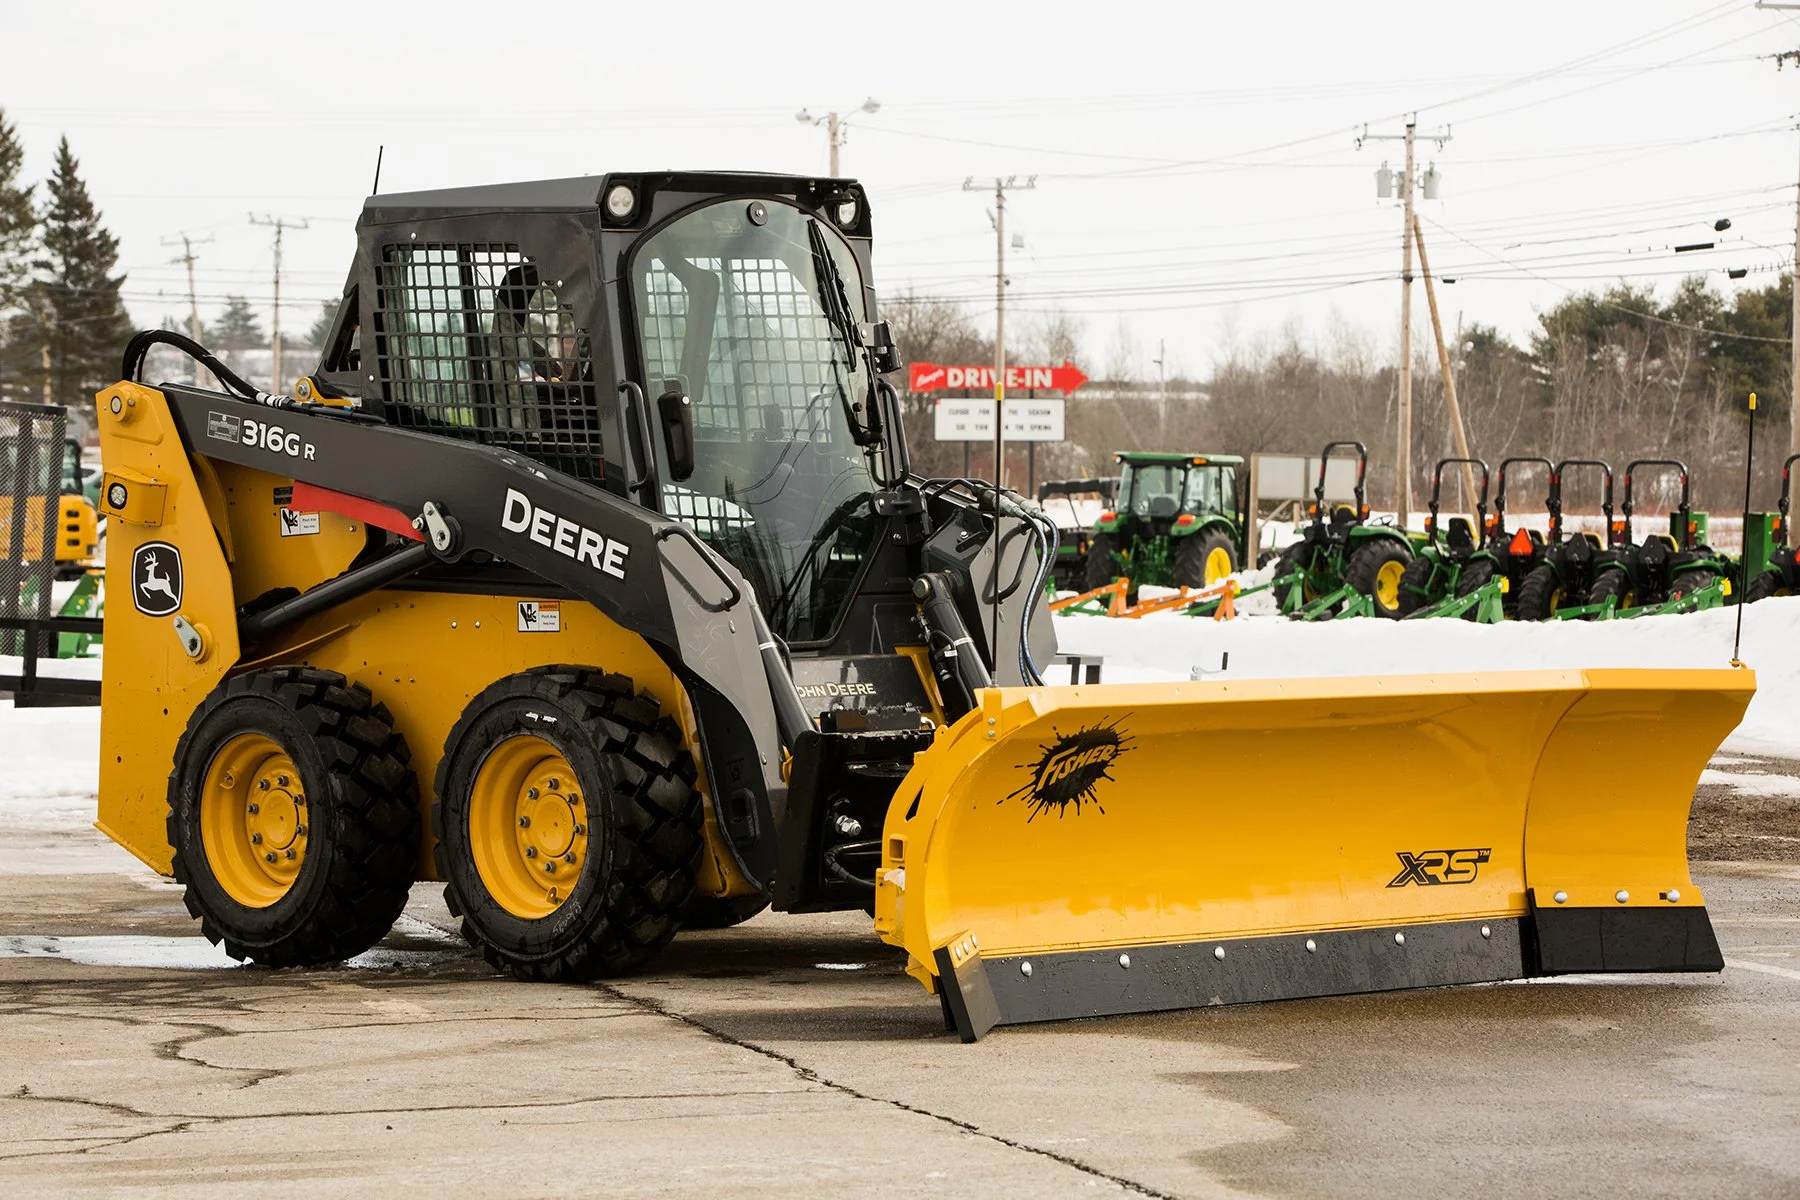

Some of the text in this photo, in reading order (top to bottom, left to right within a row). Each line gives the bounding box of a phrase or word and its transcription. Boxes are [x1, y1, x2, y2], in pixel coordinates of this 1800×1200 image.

[947, 368, 1052, 388] DRIVE-IN
[1028, 408, 1051, 416] SEASON
[242, 419, 301, 457] 316G
[304, 443, 316, 461] R
[501, 487, 630, 580] DEERE
[796, 682, 877, 698] OHN DEERE
[1035, 744, 1117, 792] FISHER
[1386, 850, 1480, 888] XRS
